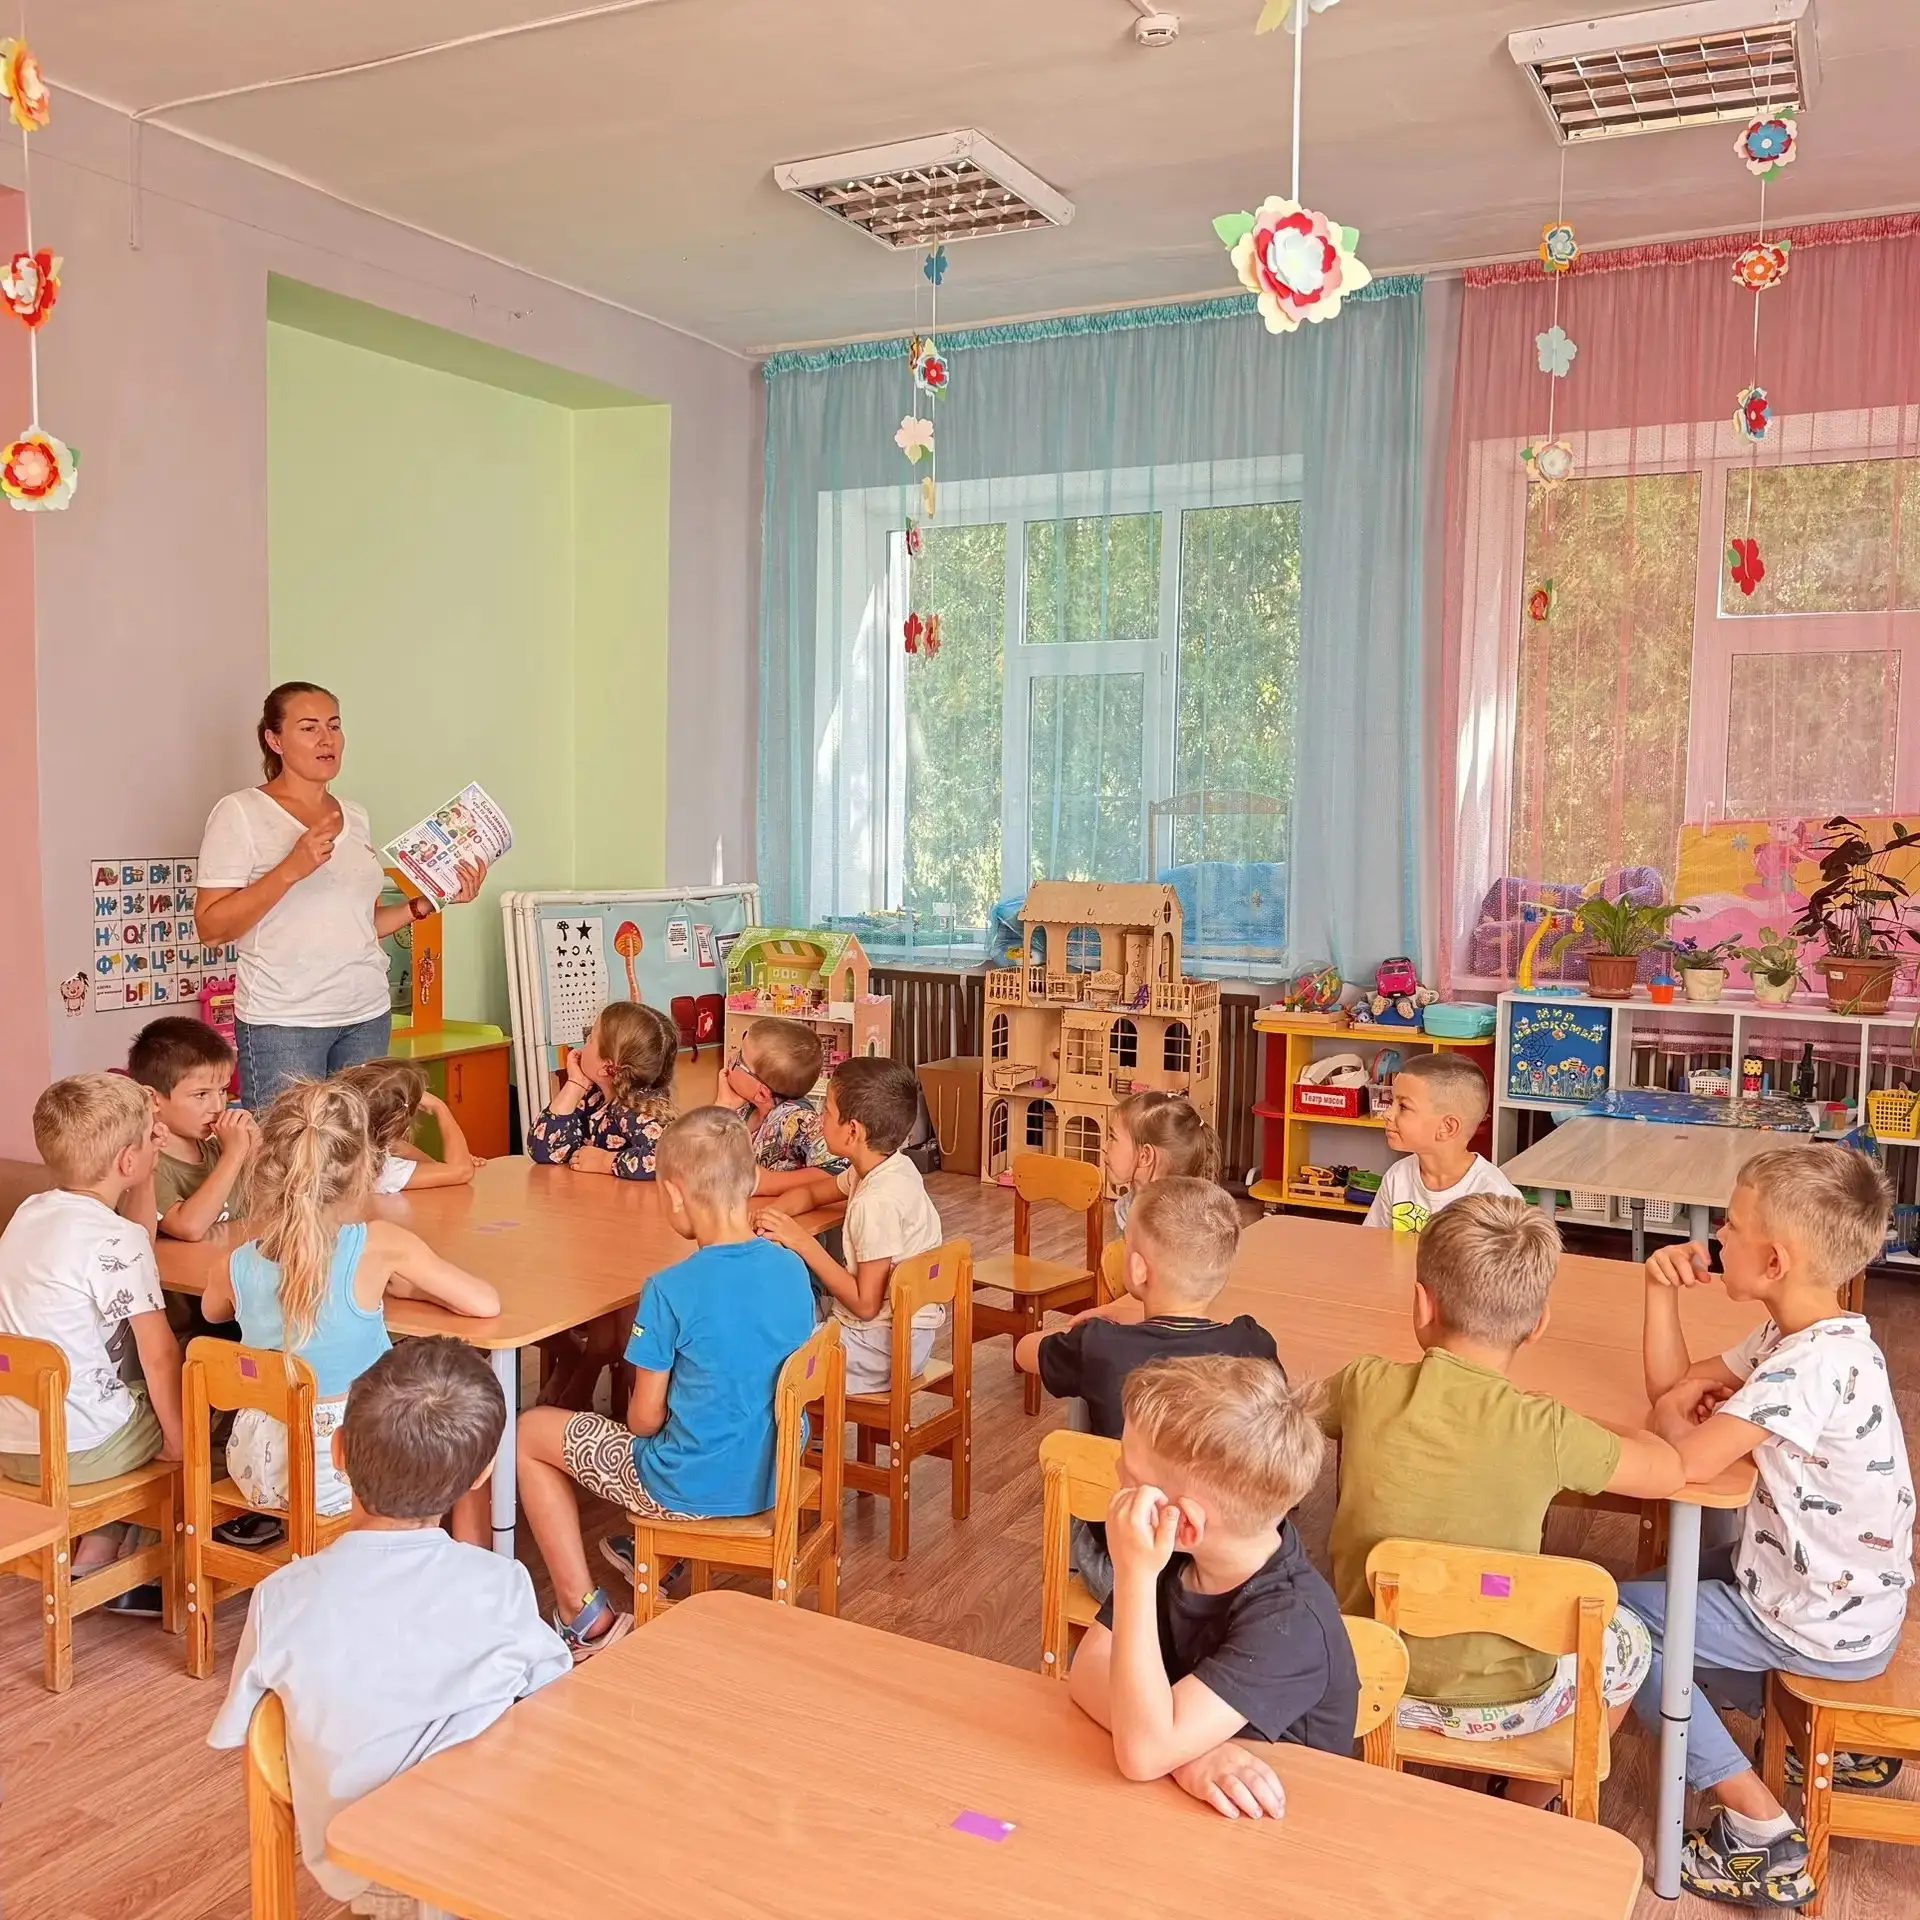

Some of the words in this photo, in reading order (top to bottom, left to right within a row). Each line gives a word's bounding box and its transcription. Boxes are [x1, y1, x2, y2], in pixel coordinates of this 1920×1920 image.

[150, 865, 162, 884] В
[177, 864, 187, 883] Г
[95, 896, 112, 916] Ж
[123, 895, 134, 914] З
[150, 894, 163, 913] И
[176, 888, 188, 912] Й
[96, 926, 110, 946] Н
[151, 921, 165, 942] П
[178, 922, 188, 940] Р
[96, 955, 113, 975] Ф
[125, 953, 139, 973] Х
[152, 950, 167, 973] Ц
[179, 949, 191, 969] Ч
[126, 983, 143, 1002] Ы
[154, 982, 167, 1000] Ь
[1304, 1093, 1323, 1105] Театр
[1323, 1096, 1344, 1106] масок
[1465, 1720, 1497, 1735] car
